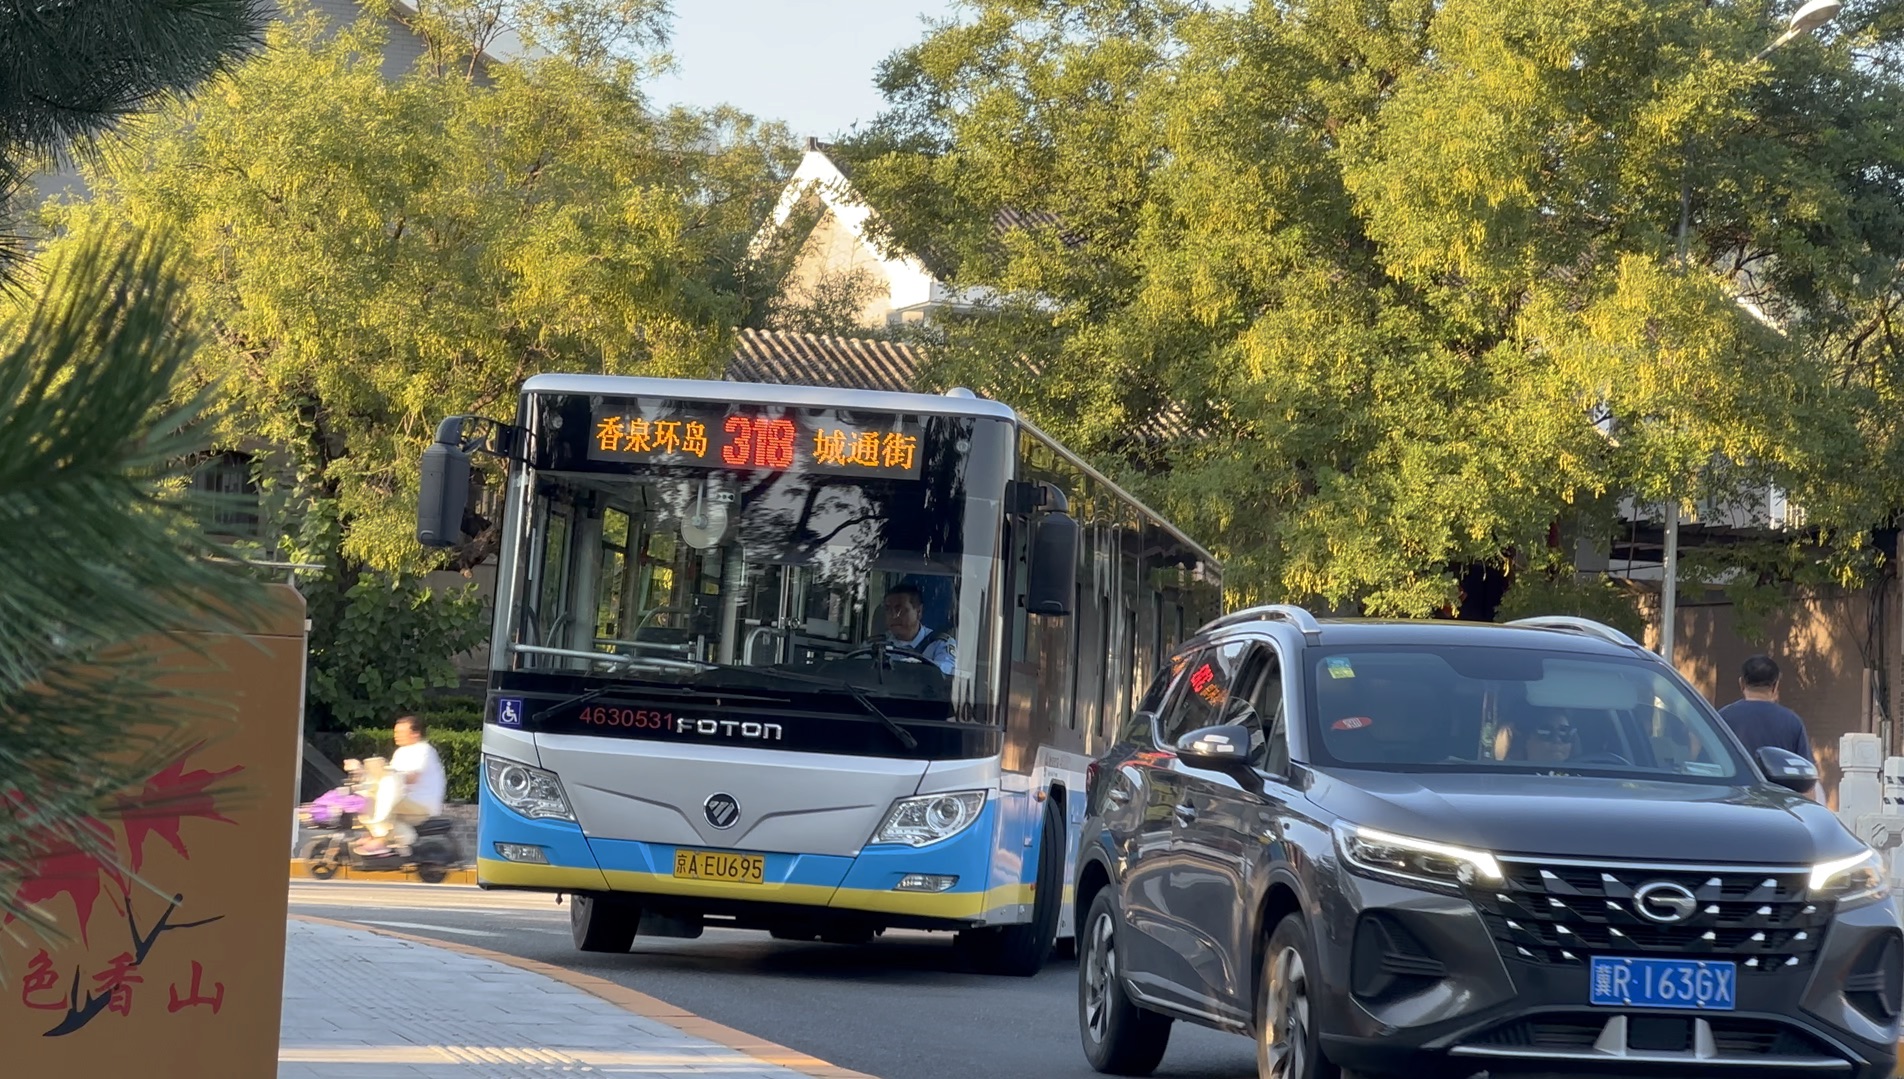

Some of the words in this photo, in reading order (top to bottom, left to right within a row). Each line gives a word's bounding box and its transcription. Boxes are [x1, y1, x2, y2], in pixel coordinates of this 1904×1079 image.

[596, 416, 707, 457] 香泉环岛
[722, 417, 796, 466] 318
[812, 429, 917, 469] 城通街
[579, 707, 673, 730] 4630531
[676, 717, 782, 740] FOTON
